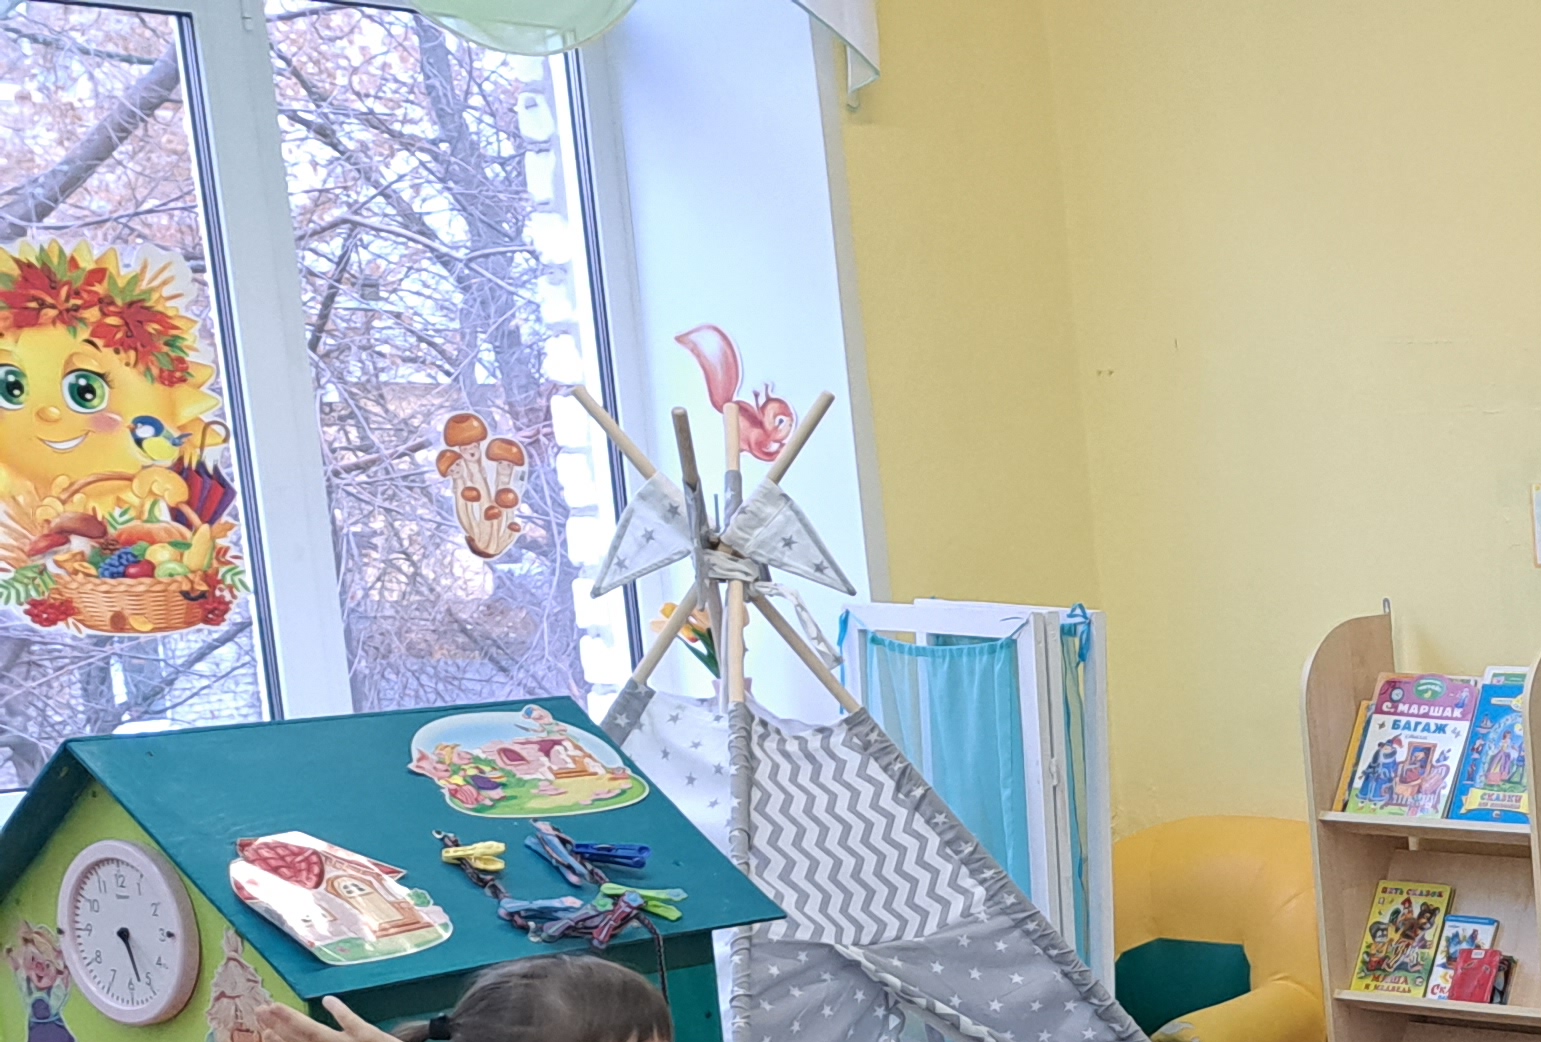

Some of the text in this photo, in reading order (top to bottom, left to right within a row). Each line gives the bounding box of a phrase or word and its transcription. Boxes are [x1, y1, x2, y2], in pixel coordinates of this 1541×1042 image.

[1397, 703, 1463, 718] МАРШАК
[1391, 719, 1449, 734] БАГАЖ
[114, 872, 126, 888] 12
[90, 898, 100, 913] 10
[151, 901, 160, 917] 2
[85, 923, 93, 937] 9
[158, 928, 167, 942] 3
[94, 949, 103, 964] 8
[156, 956, 163, 966] 4
[128, 977, 136, 991] 6
[145, 971, 152, 986] 5
[1371, 974, 1409, 985] МАША
